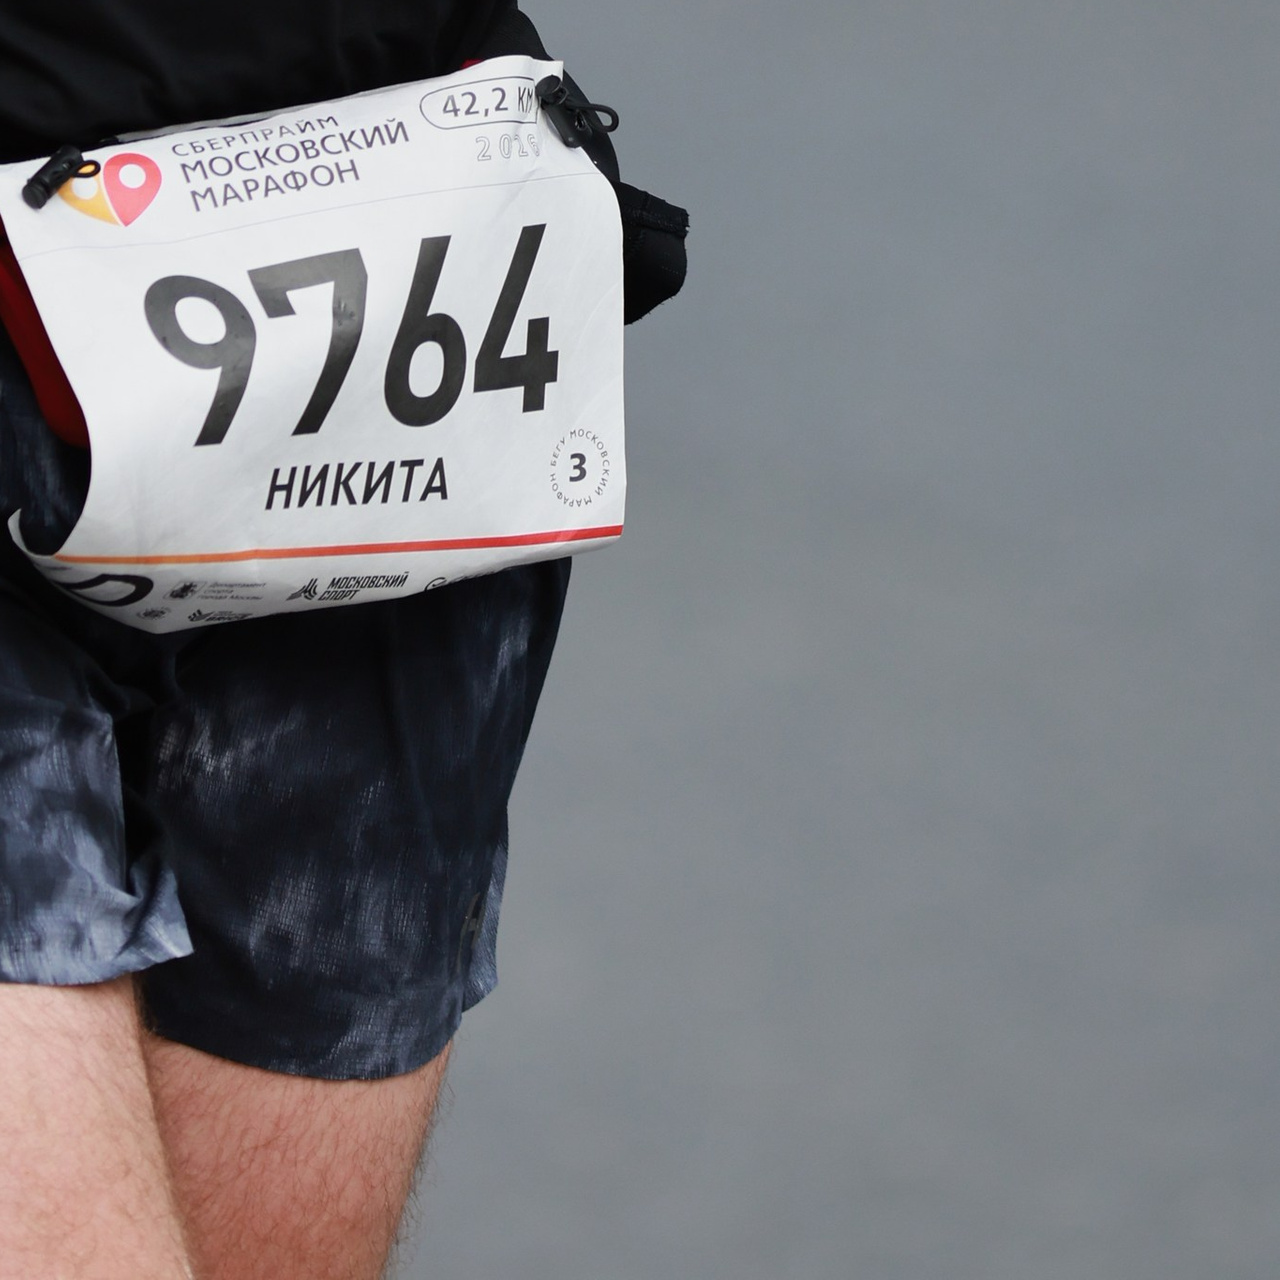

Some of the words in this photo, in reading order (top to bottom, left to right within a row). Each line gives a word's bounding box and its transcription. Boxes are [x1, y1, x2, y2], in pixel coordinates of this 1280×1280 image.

[442, 87, 509, 117] 42,2
[171, 115, 339, 157] СБЕРПРАЙМ
[179, 117, 410, 184] МОСКОВСКИЙ
[190, 159, 360, 212] МАРАФОН
[144, 223, 559, 447] 9764
[550, 436, 565, 467] БЕГУ
[569, 452, 587, 482] 3
[570, 428, 610, 496] МОСКОВСКИЙ
[265, 457, 449, 511] НИКИТА
[550, 473, 592, 507] МАРАФОН
[318, 589, 360, 601] СПОРТ
[326, 571, 410, 590] МОСКОВСКИЙ
